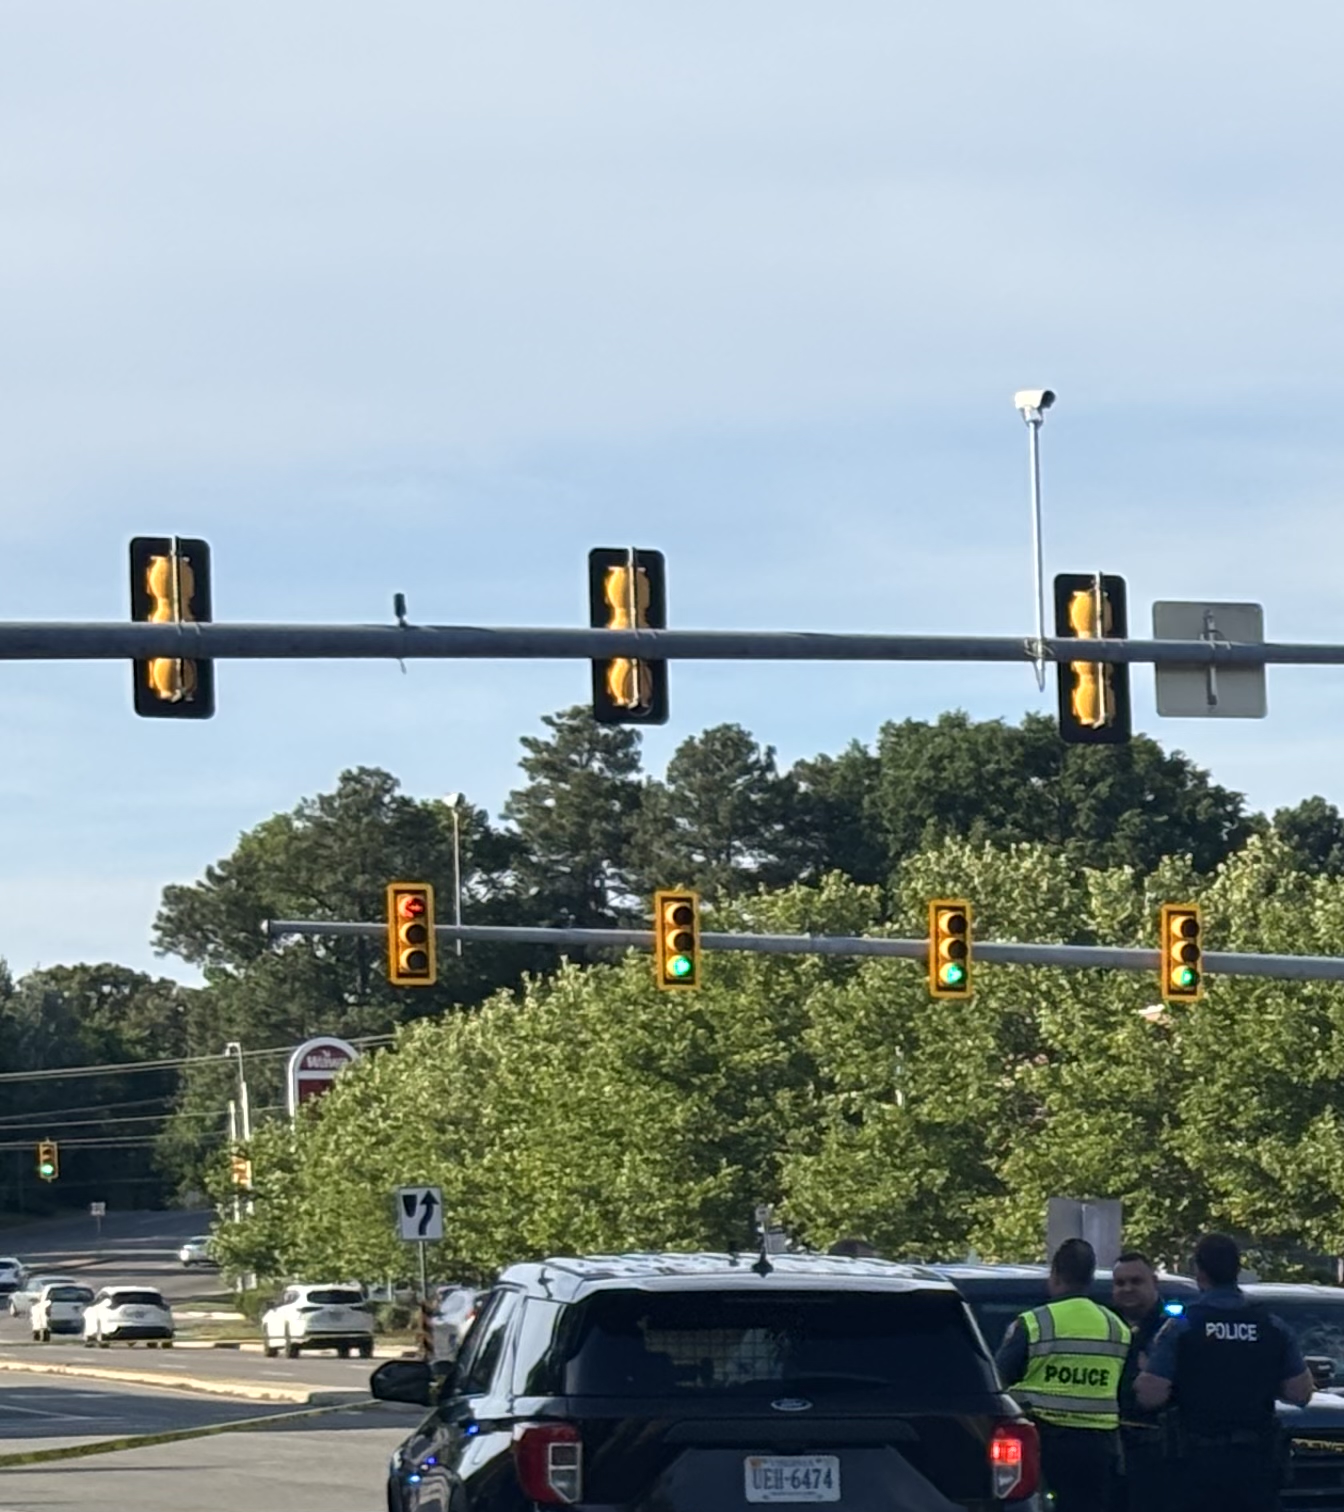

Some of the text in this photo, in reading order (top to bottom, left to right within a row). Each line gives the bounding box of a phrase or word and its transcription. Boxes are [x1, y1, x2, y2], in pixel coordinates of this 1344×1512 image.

[1205, 1321, 1258, 1342] POLICE
[1043, 1364, 1110, 1387] POLICE
[752, 1467, 834, 1491] UEH-6474
